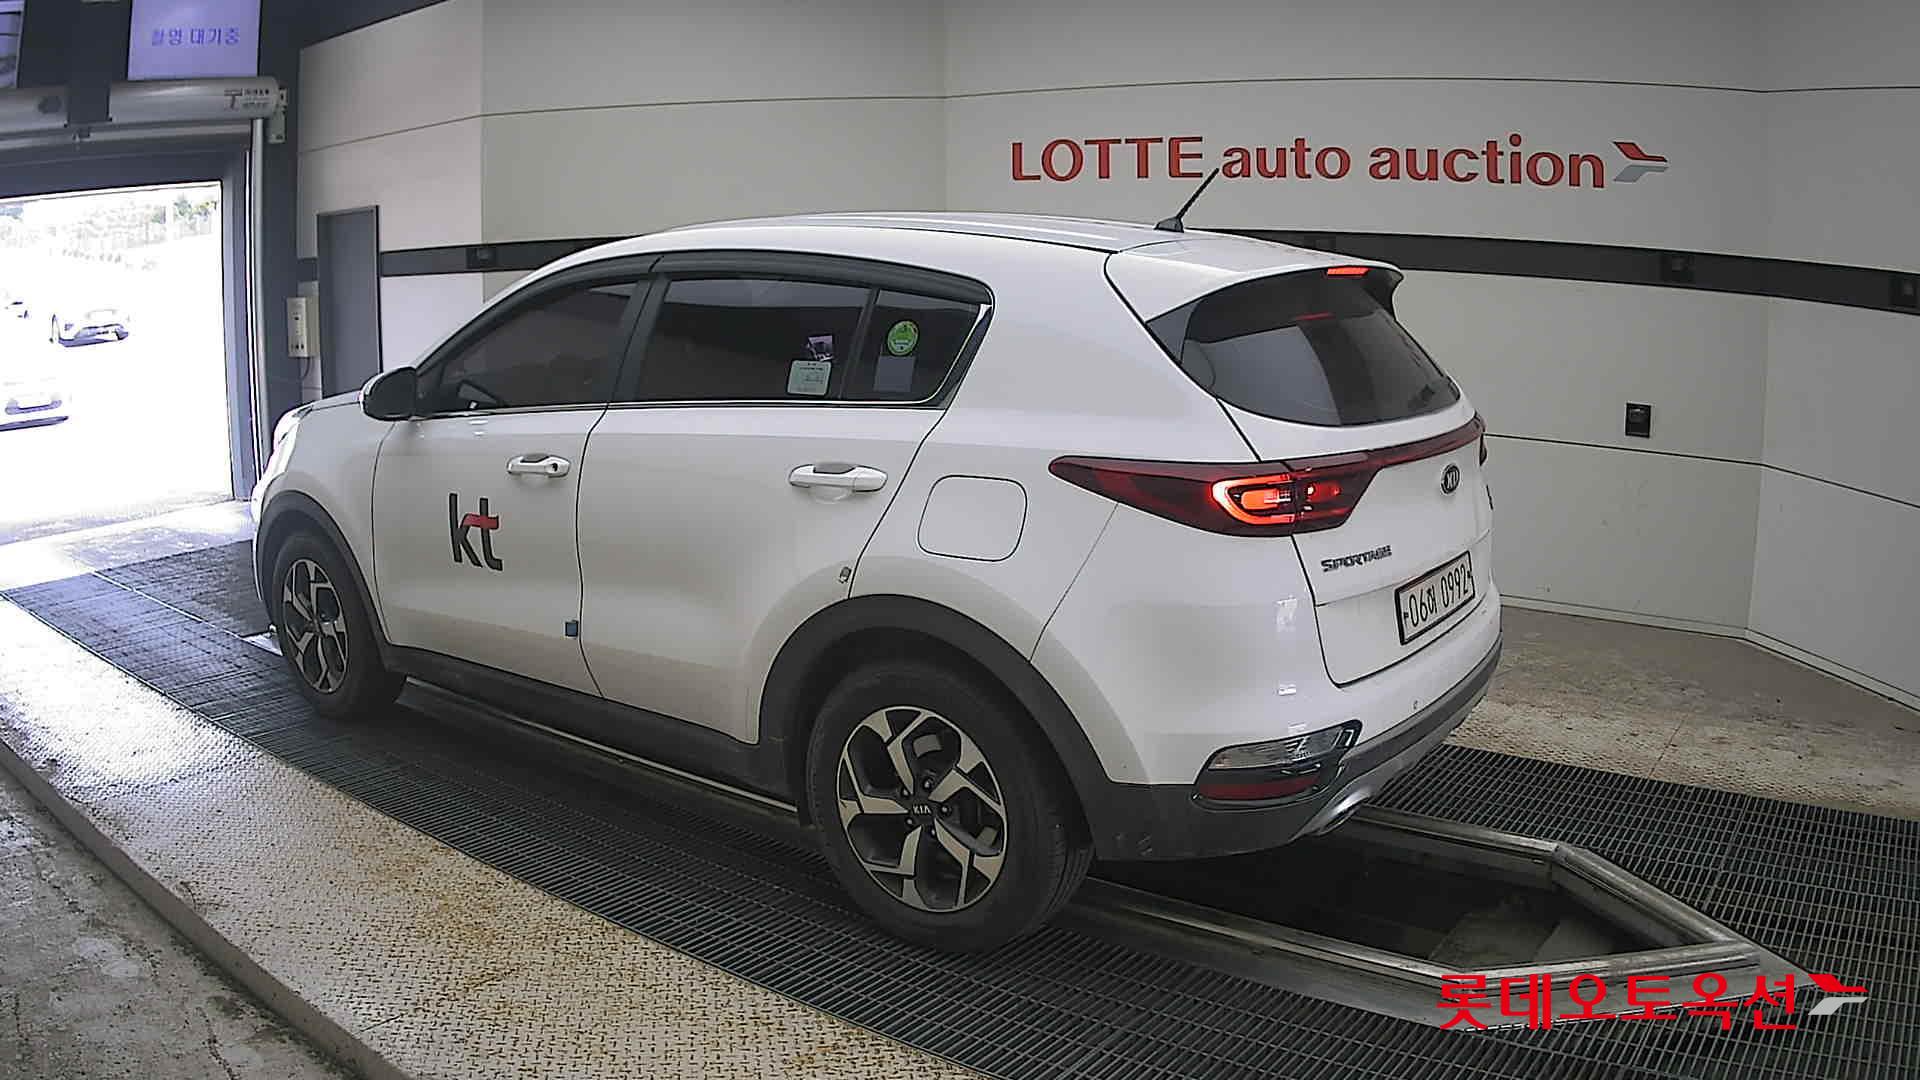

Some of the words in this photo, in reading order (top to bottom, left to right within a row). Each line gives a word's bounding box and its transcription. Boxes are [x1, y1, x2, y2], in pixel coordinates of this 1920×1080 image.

[1011, 136, 1204, 182] LOTTE
[1221, 136, 1352, 180] auto
[1368, 133, 1606, 189] auction
[448, 492, 504, 571] kt
[1320, 545, 1393, 573] SPORTAGE
[1440, 564, 1468, 608] 0992
[912, 804, 932, 815] KIA
